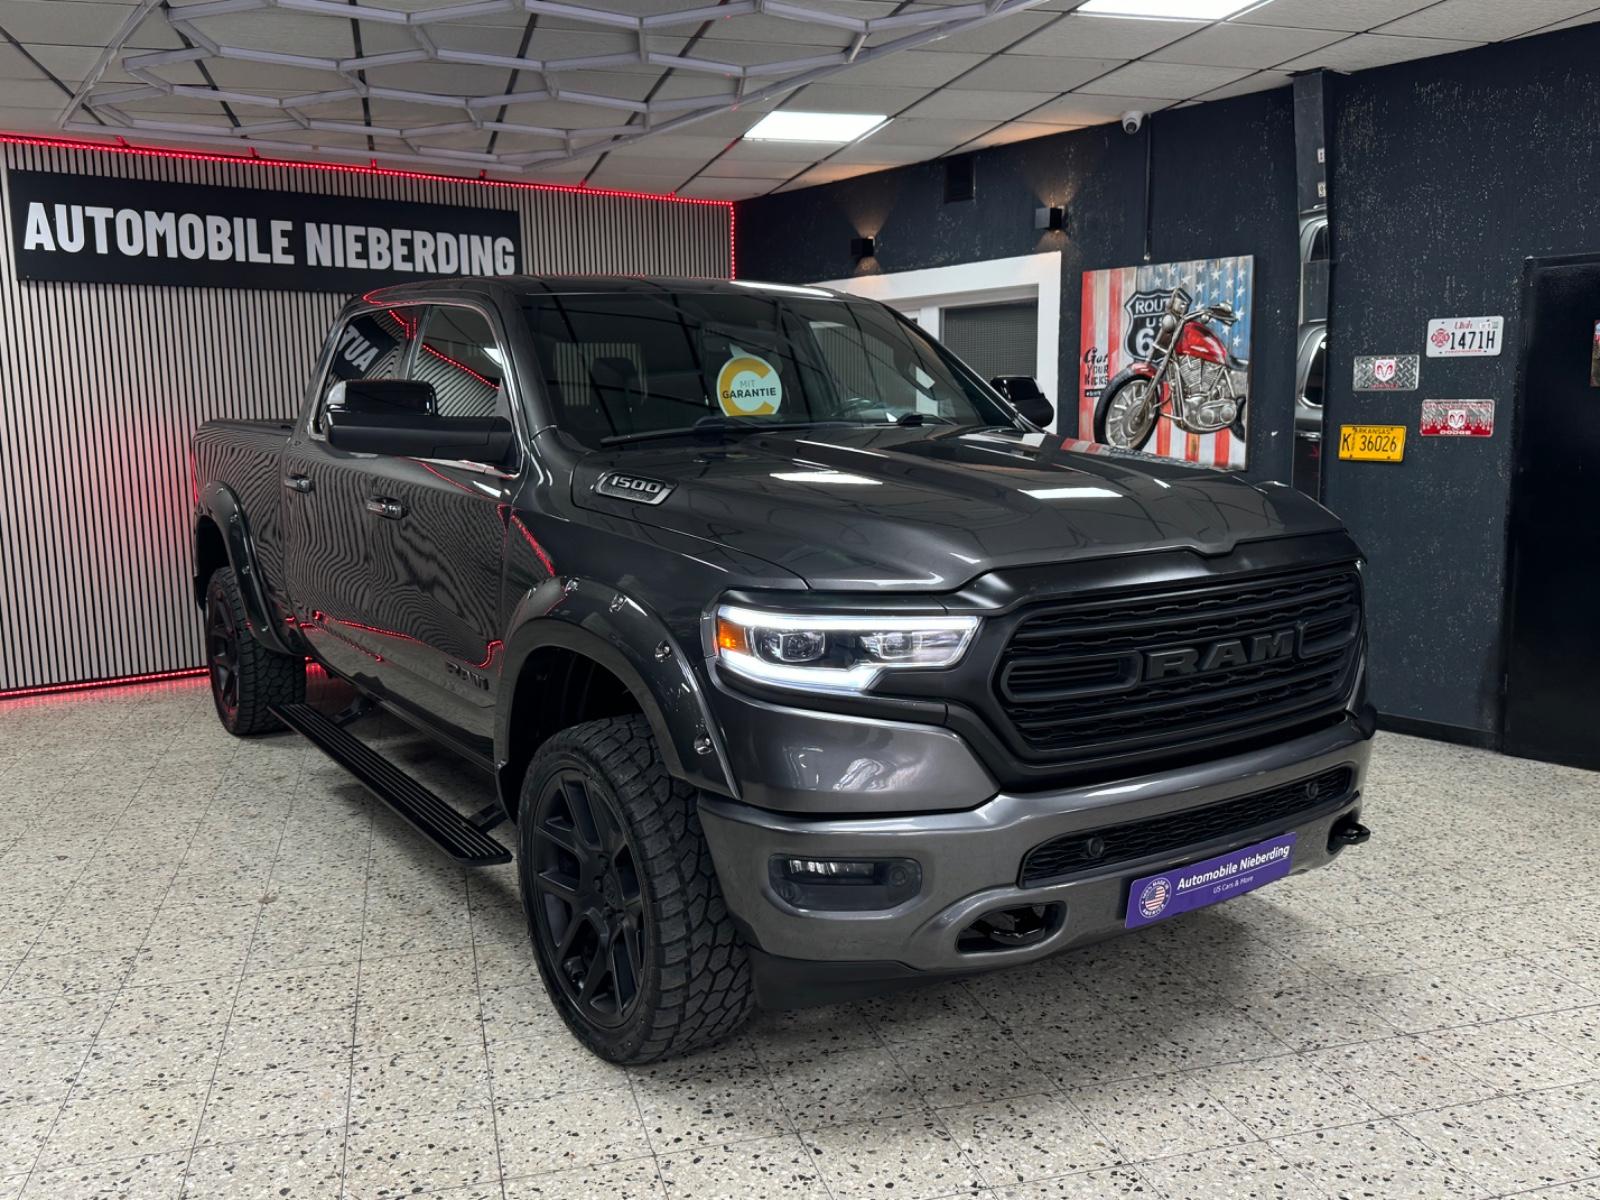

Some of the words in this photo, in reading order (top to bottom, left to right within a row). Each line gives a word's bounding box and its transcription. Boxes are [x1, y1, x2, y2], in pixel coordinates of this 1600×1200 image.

[23, 202, 295, 265] AUTOMOBILE
[305, 222, 516, 277] NIEBERDING
[1135, 298, 1170, 314] ROUT
[1450, 330, 1496, 350] 1471H
[722, 387, 777, 399] GARANTIE
[739, 380, 756, 388] MIT
[1342, 433, 1352, 451] K
[1359, 434, 1398, 452] 36026
[611, 475, 662, 493] 1500
[1145, 629, 1296, 681] RAM
[1176, 862, 1238, 890] Automobile
[1239, 845, 1291, 870] Nieberding
